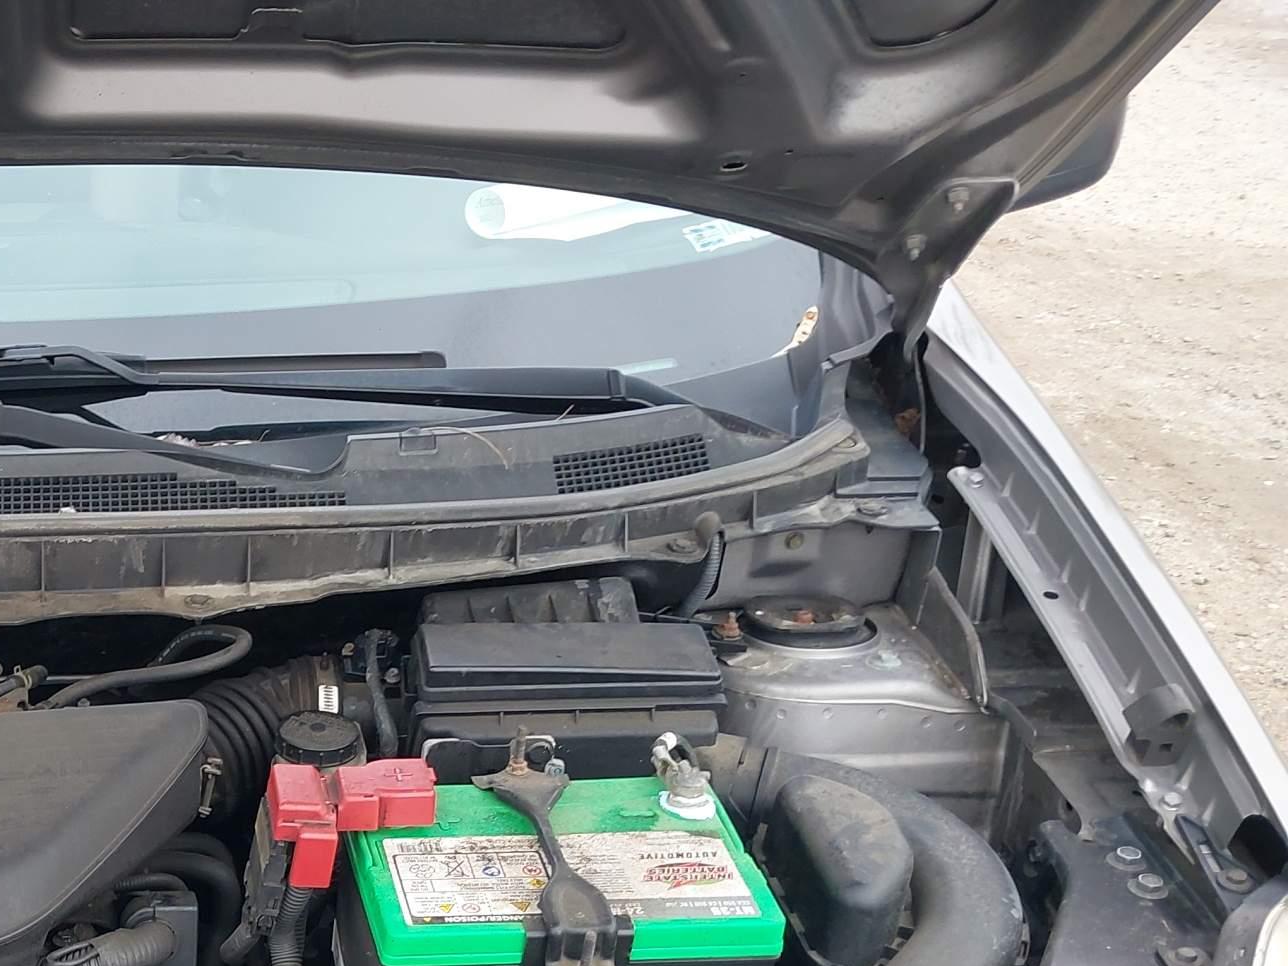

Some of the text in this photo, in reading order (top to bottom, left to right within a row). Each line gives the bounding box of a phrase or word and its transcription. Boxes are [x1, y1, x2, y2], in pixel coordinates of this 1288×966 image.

[638, 851, 718, 860] AUTOMOTIVE
[646, 866, 727, 875] BATTERIES
[643, 873, 733, 882] INTERSTATE
[444, 915, 528, 923] ANGER/POISON
